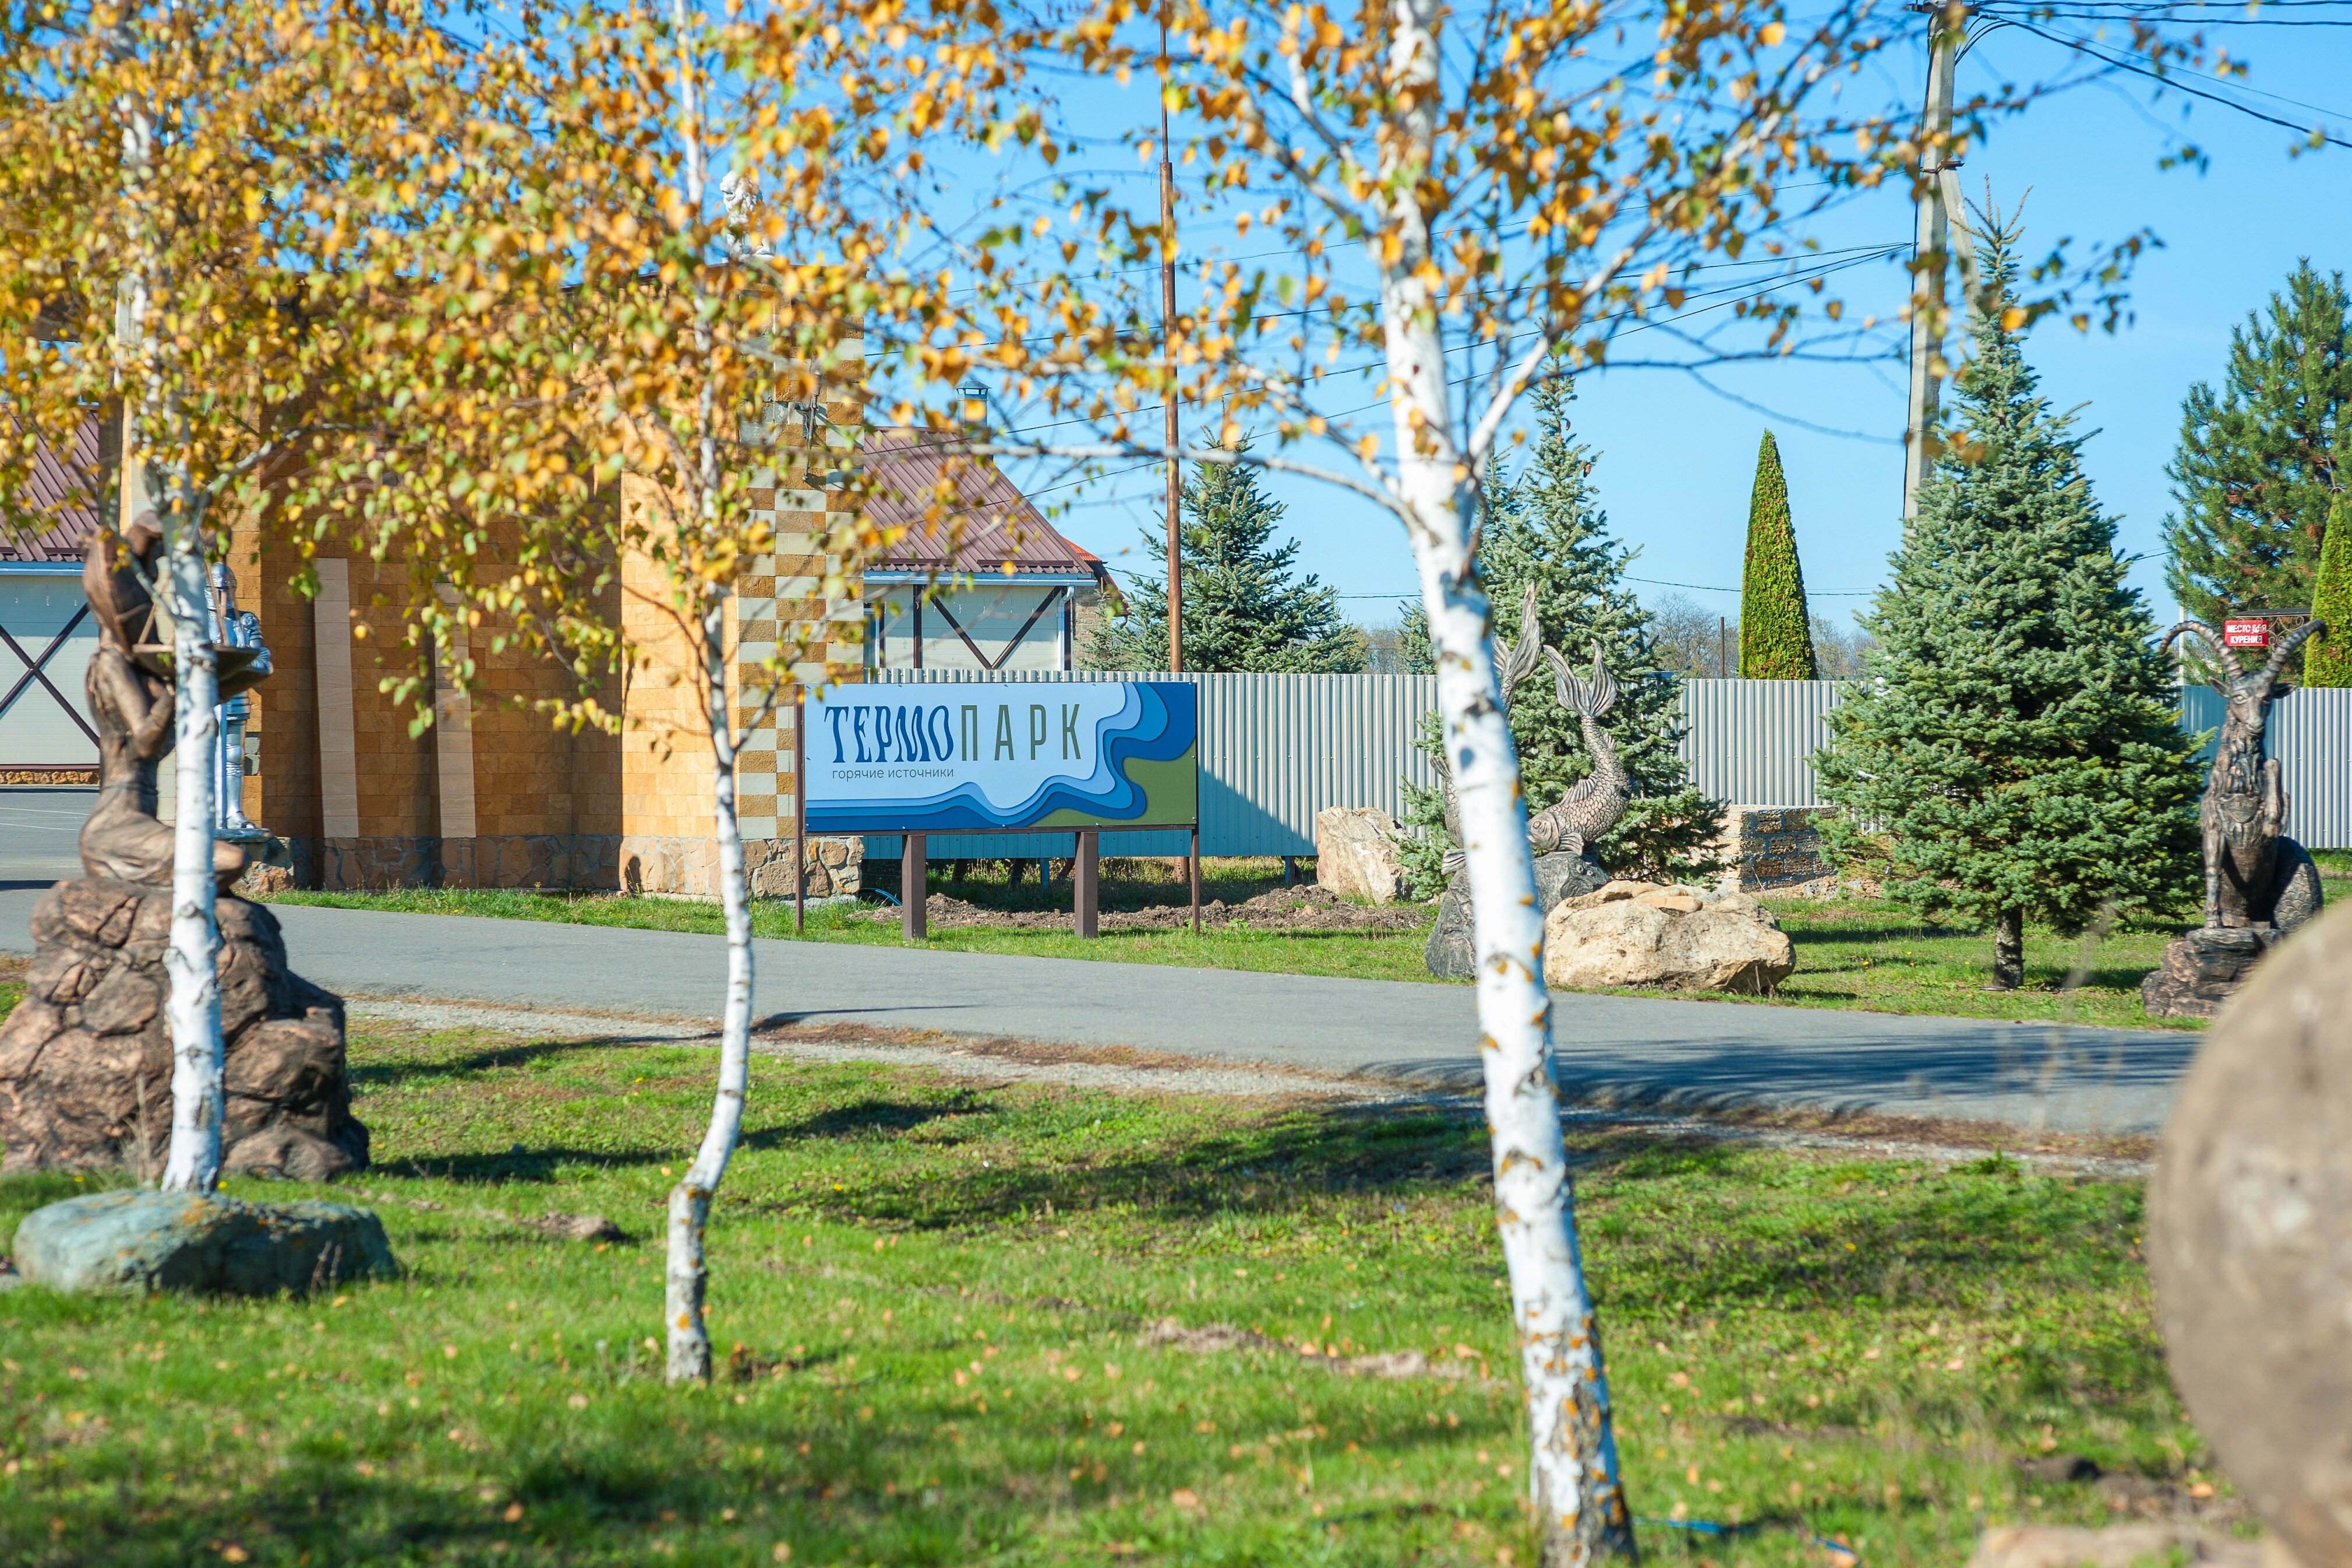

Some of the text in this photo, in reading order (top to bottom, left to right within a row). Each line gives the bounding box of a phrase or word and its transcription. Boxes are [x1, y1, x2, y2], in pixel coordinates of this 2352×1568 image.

[824, 704, 1081, 762] ТЕРМОПАРК
[832, 767, 954, 781] горячие источники
